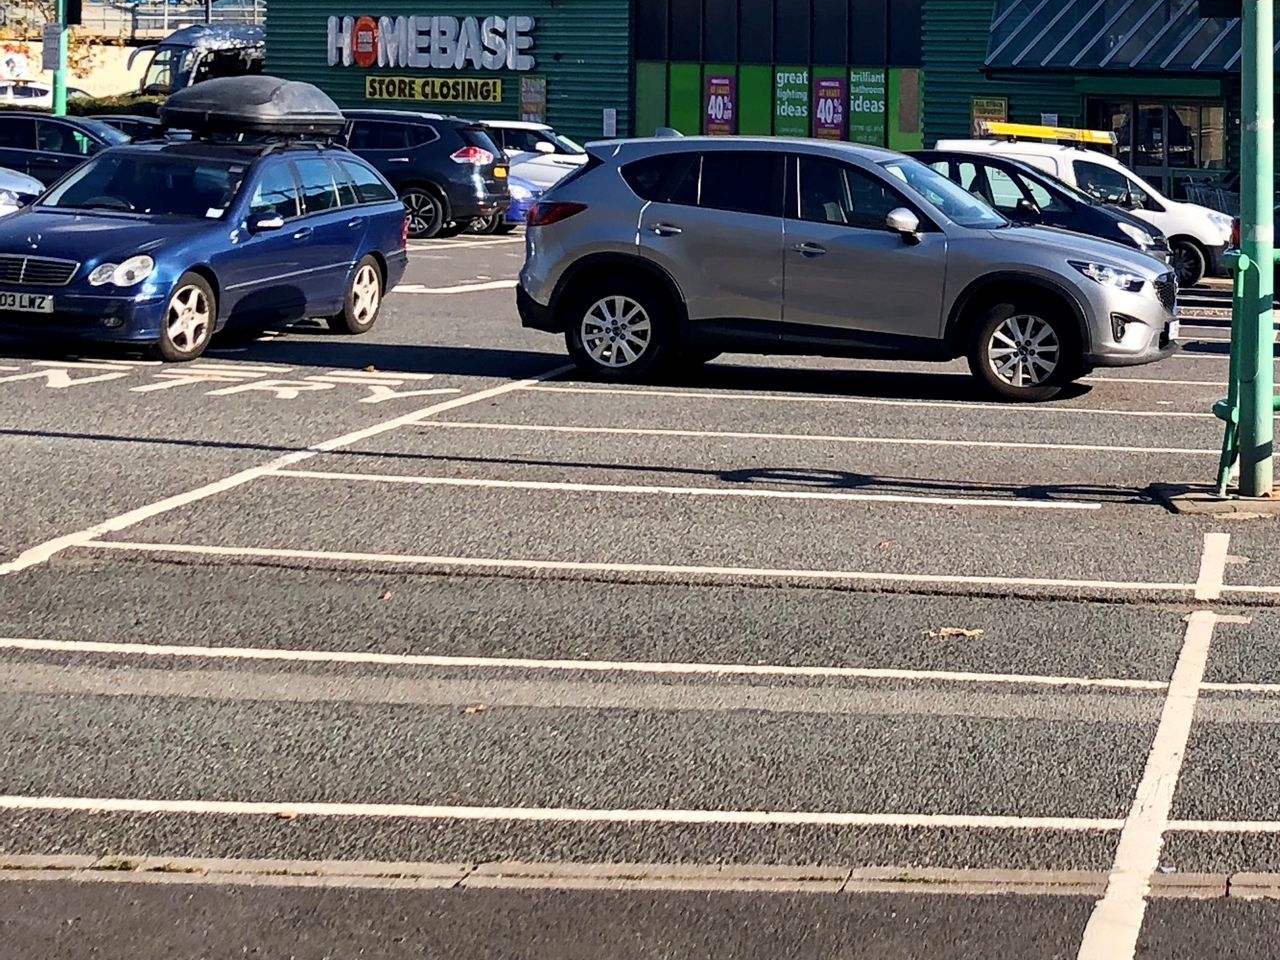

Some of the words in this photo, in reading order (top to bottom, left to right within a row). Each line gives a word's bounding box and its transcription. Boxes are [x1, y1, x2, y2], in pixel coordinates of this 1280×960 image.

[327, 15, 536, 70] HOMEBASE
[776, 72, 808, 87] great
[850, 71, 885, 84] brilliant
[368, 78, 416, 99] STORE
[420, 79, 499, 101] CLOSING!
[777, 88, 808, 102] lighting
[707, 95, 732, 119] 40%
[776, 101, 809, 117] ideas
[816, 98, 843, 123] 40%
[850, 96, 885, 113] ideas
[19, 295, 46, 309] LWZ
[0, 365, 462, 404] NTRY
